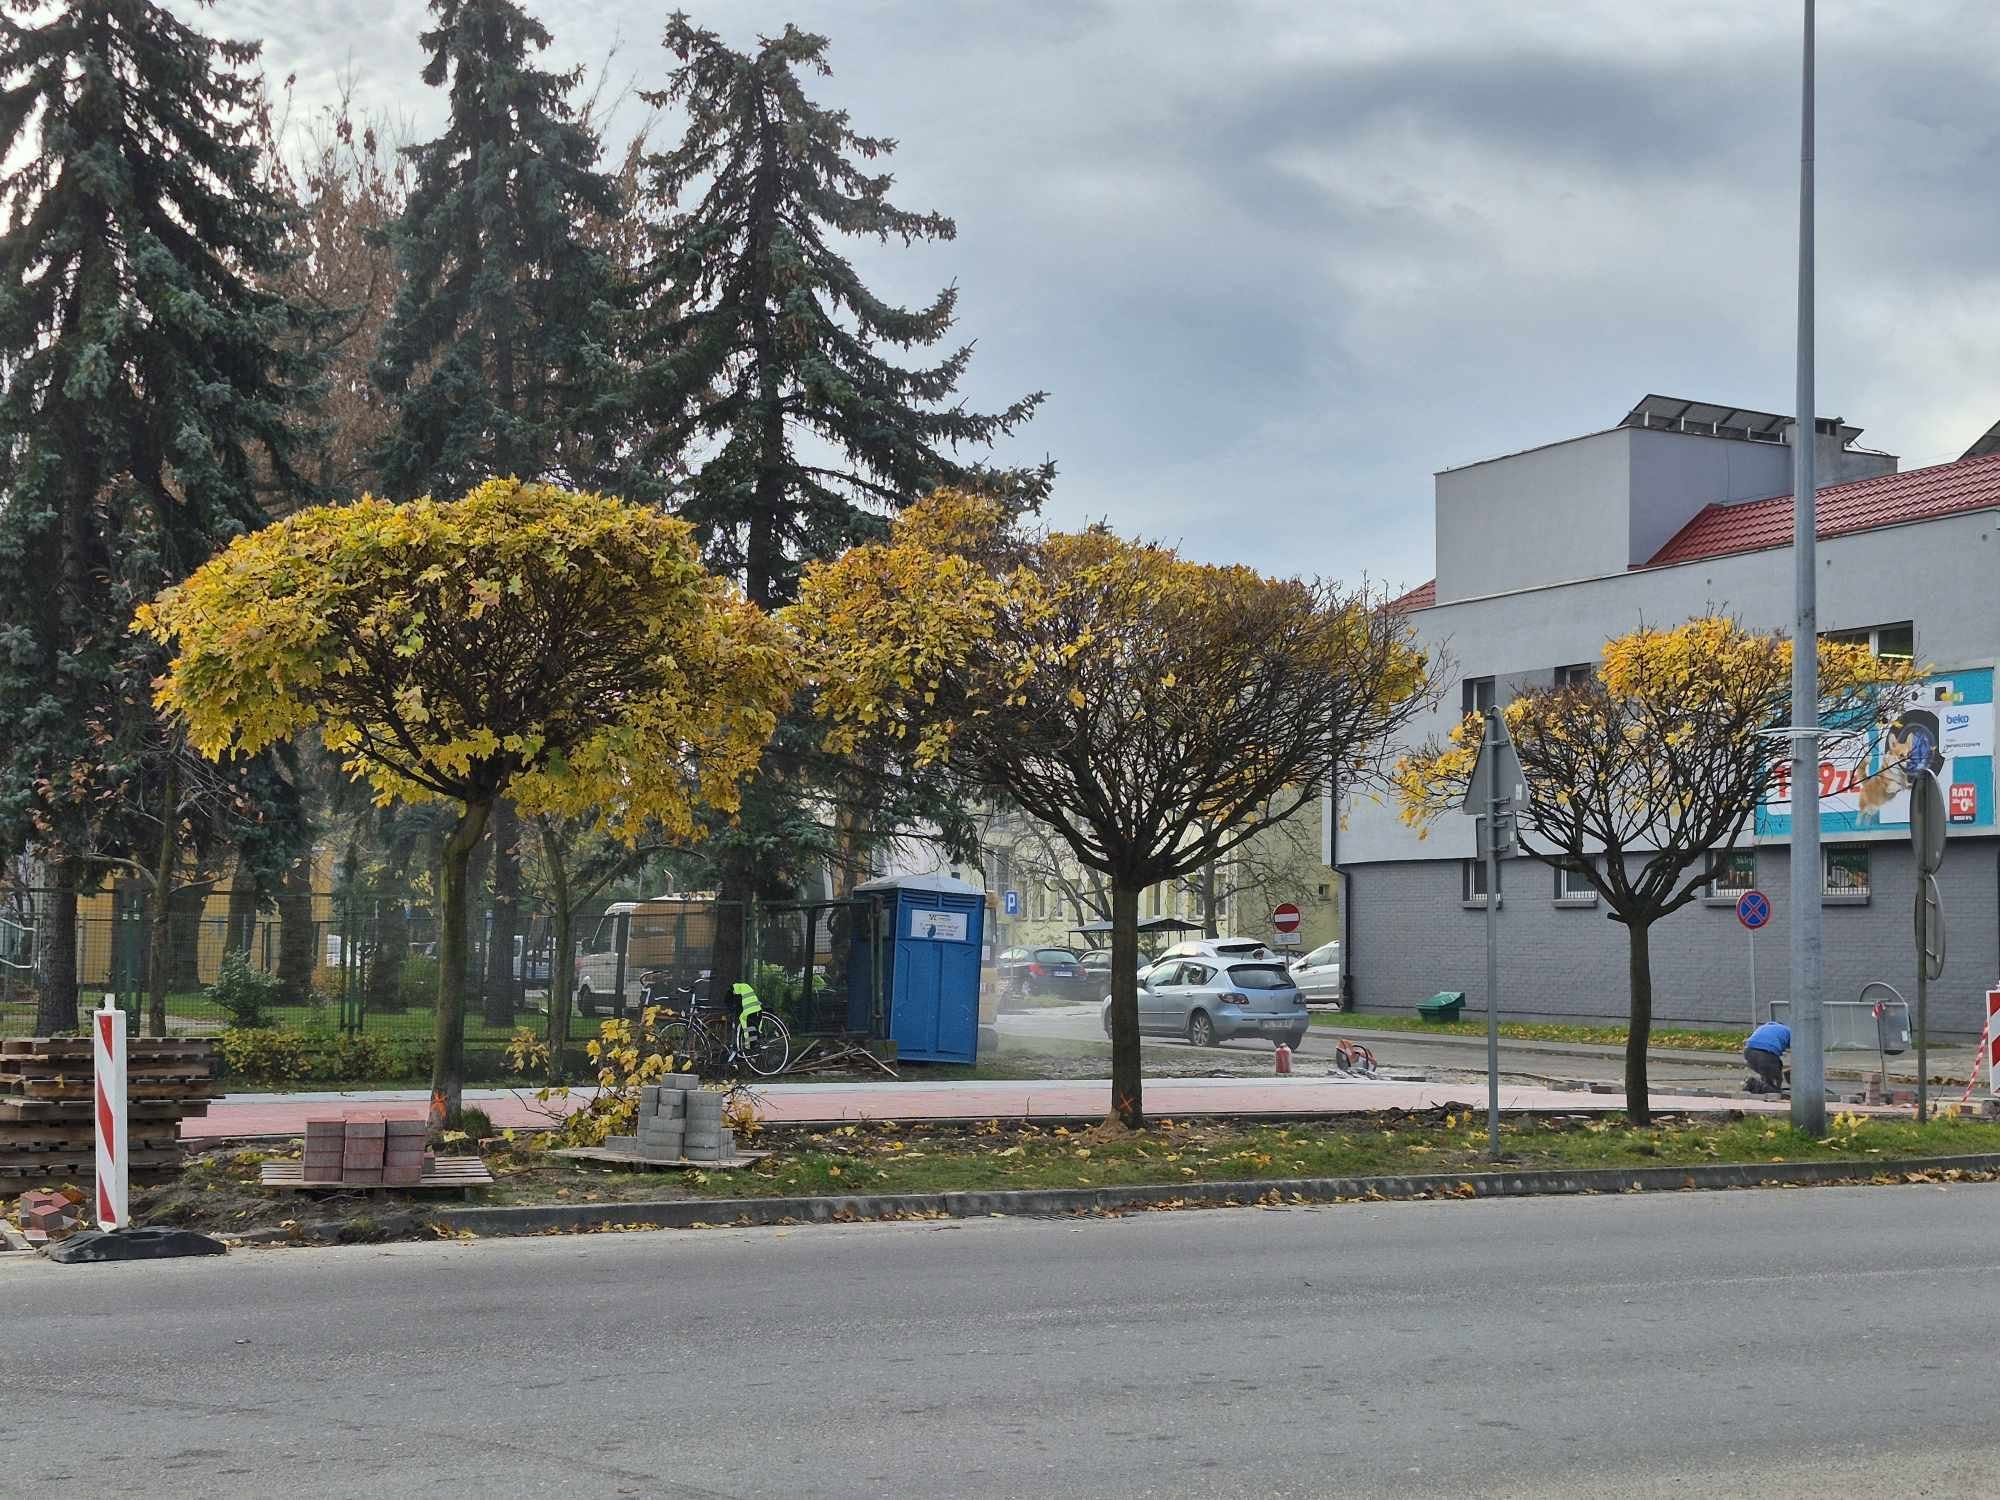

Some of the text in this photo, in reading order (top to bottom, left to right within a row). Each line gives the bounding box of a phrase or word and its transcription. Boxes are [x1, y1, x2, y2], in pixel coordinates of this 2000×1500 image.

[1946, 714, 1969, 724] beko
[1952, 787, 1974, 797] RATY
[1007, 894, 1016, 912] P
